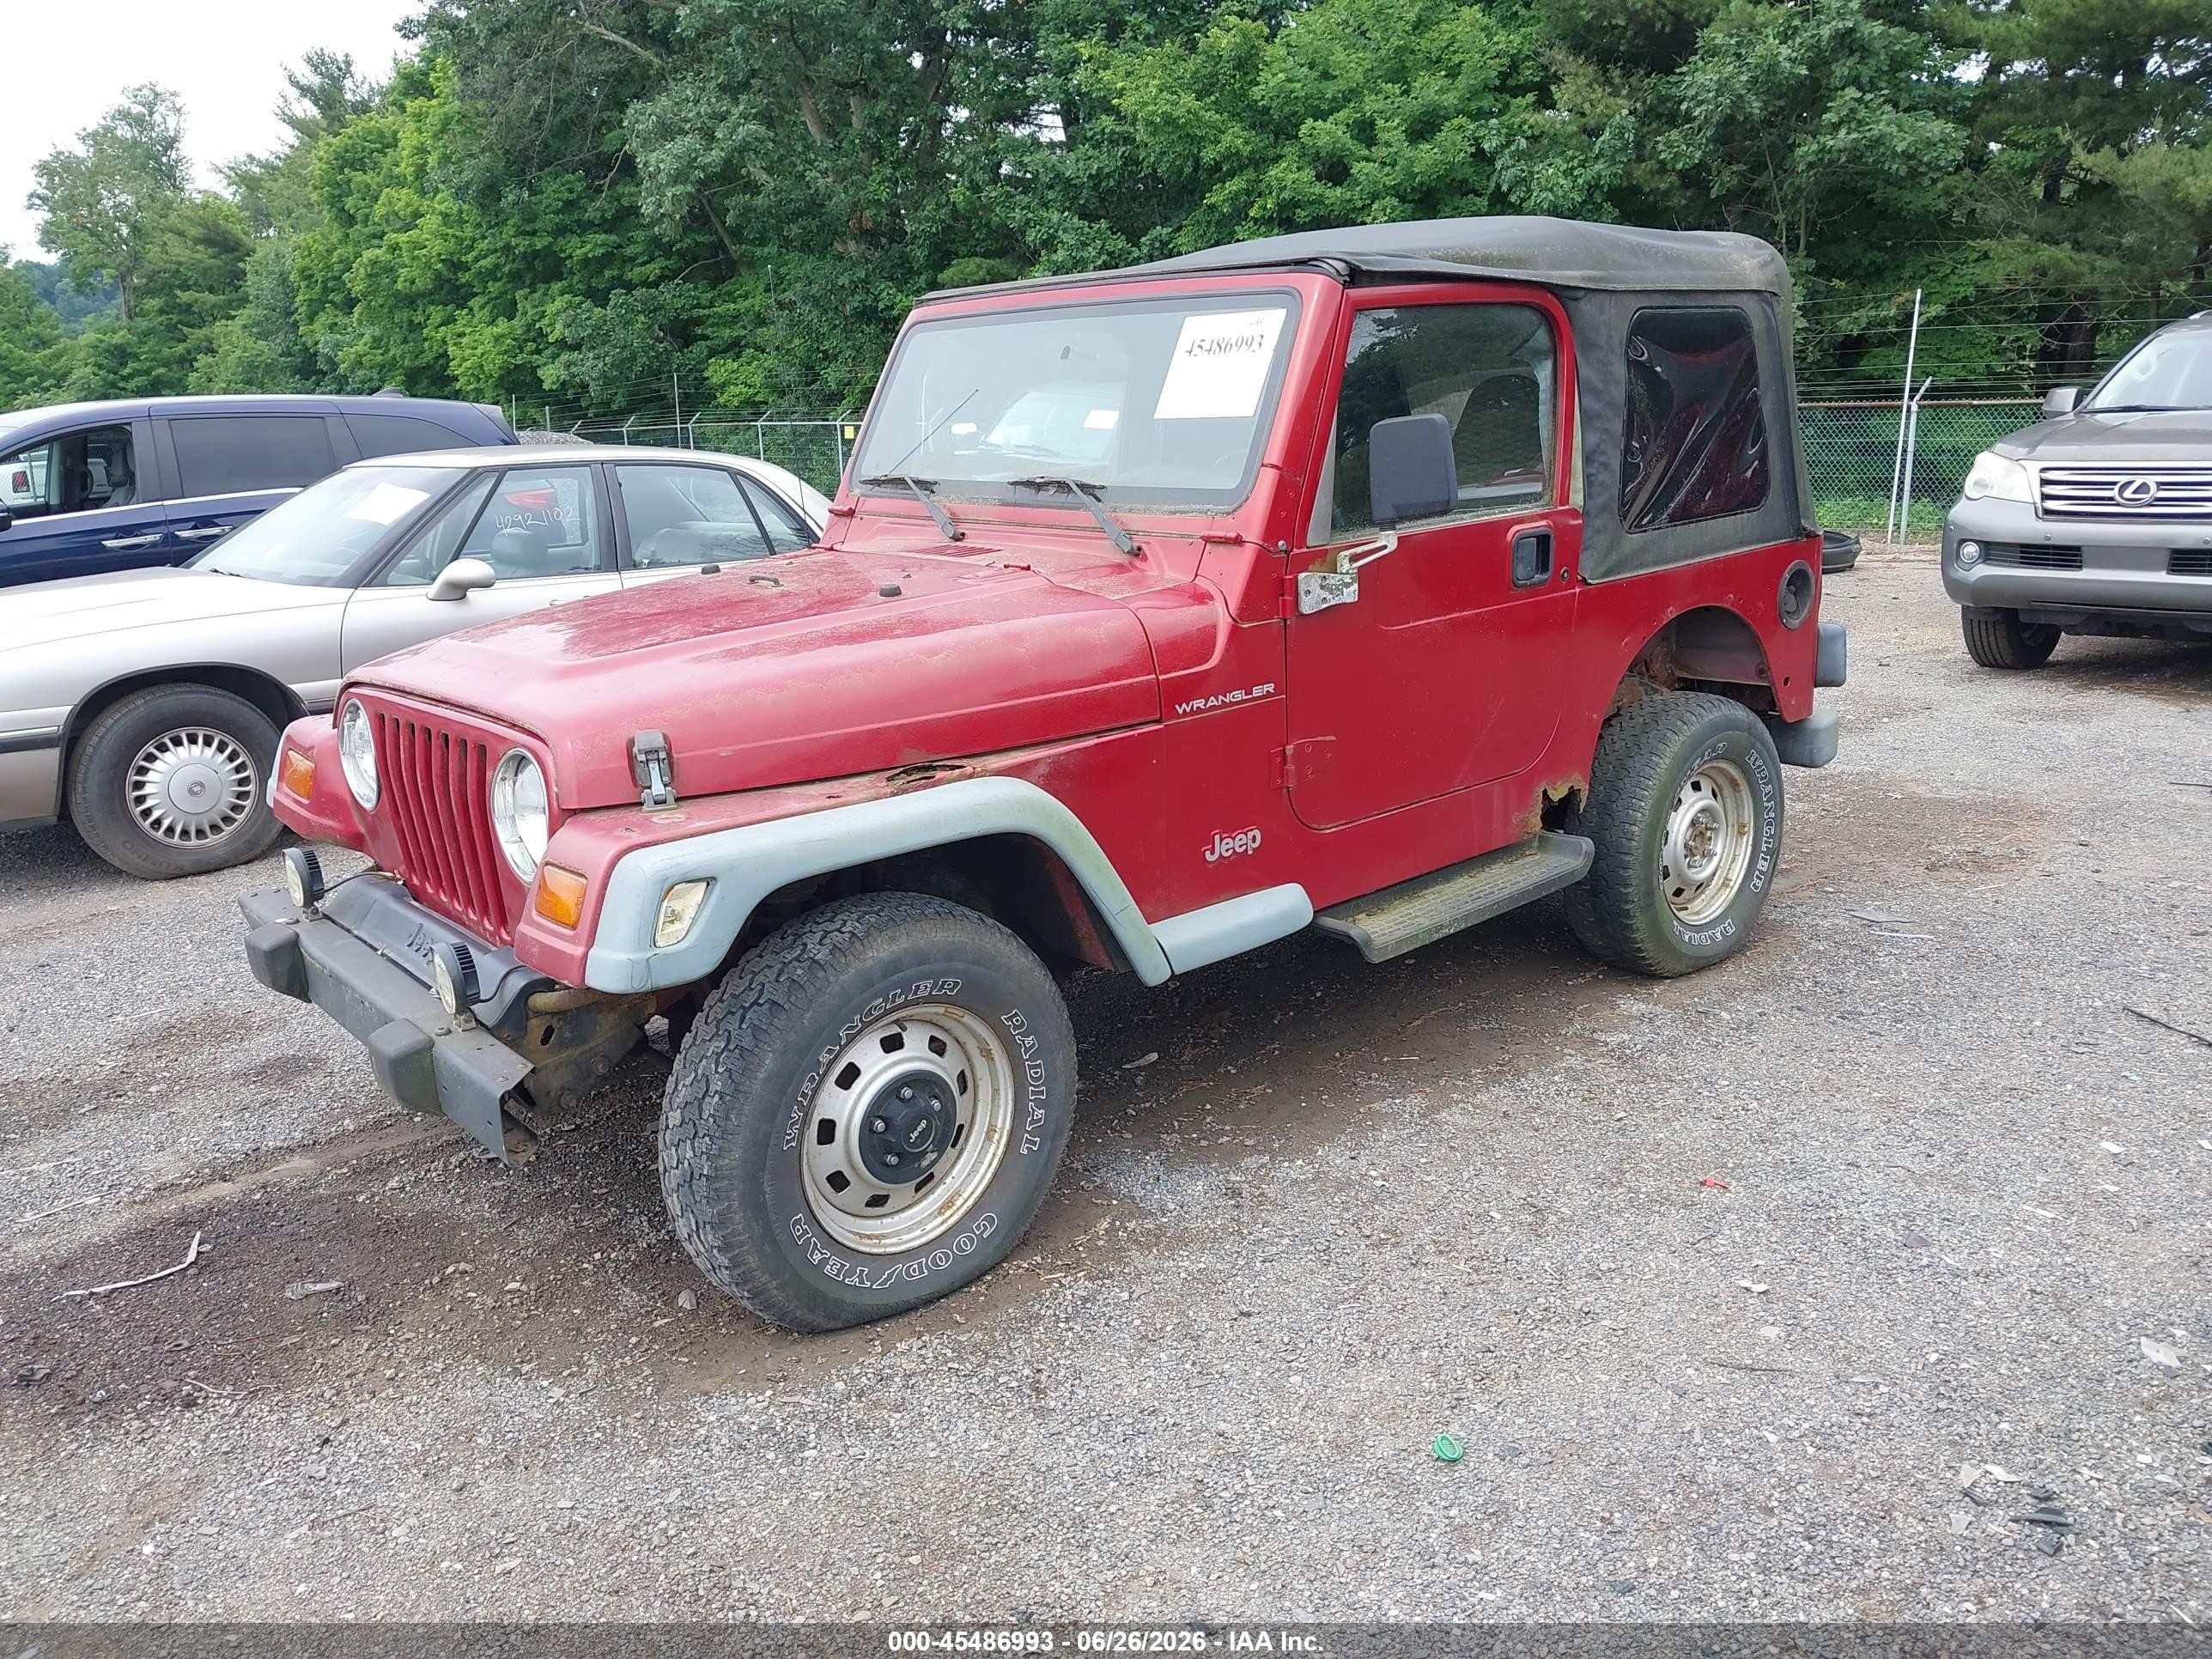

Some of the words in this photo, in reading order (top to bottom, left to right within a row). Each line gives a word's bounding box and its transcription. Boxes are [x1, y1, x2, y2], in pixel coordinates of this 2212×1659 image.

[1185, 333, 1264, 357] 45486993
[495, 507, 583, 537] 42921102
[1175, 683, 1275, 714] WRANGLER
[1745, 750, 1775, 892] WRANGLER
[1204, 829, 1261, 862] Jeep
[1673, 919, 1736, 945] RADIAL
[783, 979, 962, 1151] WRANGLER
[1000, 1009, 1045, 1155] RADIAL
[909, 1119, 927, 1143] Jeep
